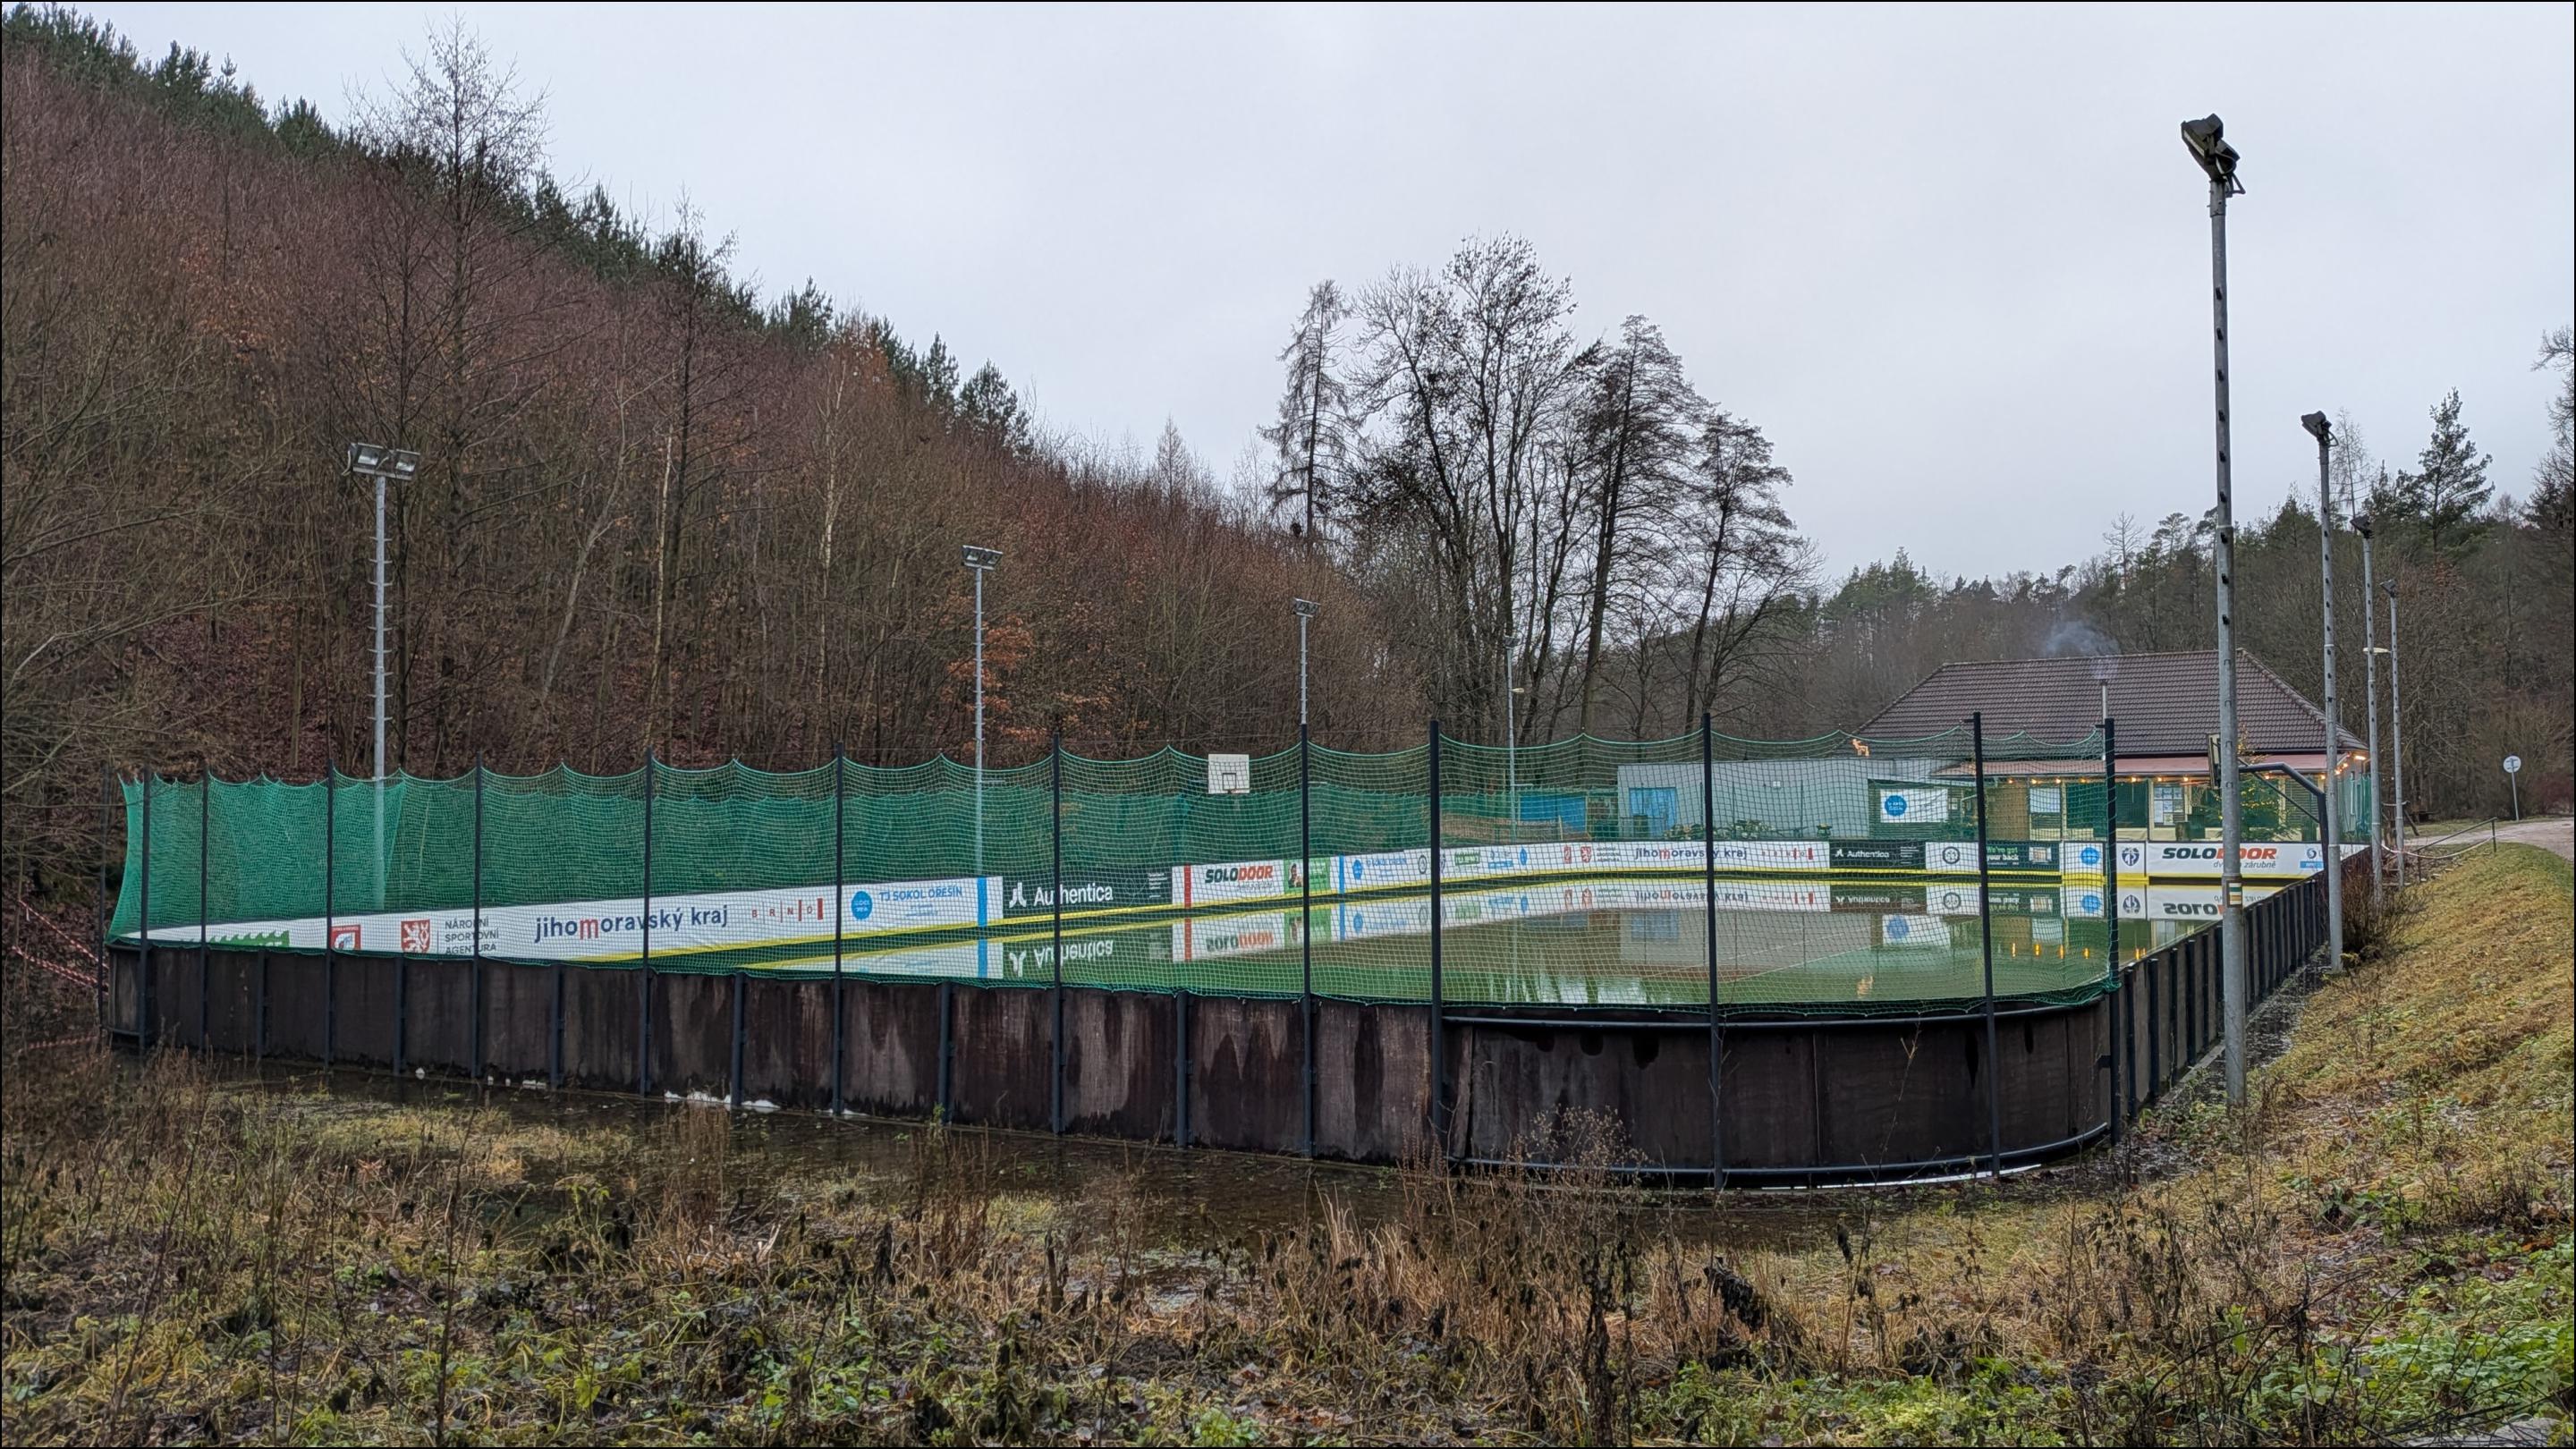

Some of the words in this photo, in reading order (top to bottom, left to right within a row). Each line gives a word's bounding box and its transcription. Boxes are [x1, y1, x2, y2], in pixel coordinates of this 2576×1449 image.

[1634, 846, 1719, 860] jihomoravsý
[1724, 847, 1747, 860] kraj
[1847, 850, 1889, 858] Authentica
[2162, 847, 2277, 860] SOLOOR
[1205, 865, 1274, 884] SOLODOOR
[893, 889, 927, 902] SOKOL
[1033, 882, 1114, 907] Auhentica
[445, 916, 488, 930] NÁRONÍ
[691, 904, 728, 928] kraj
